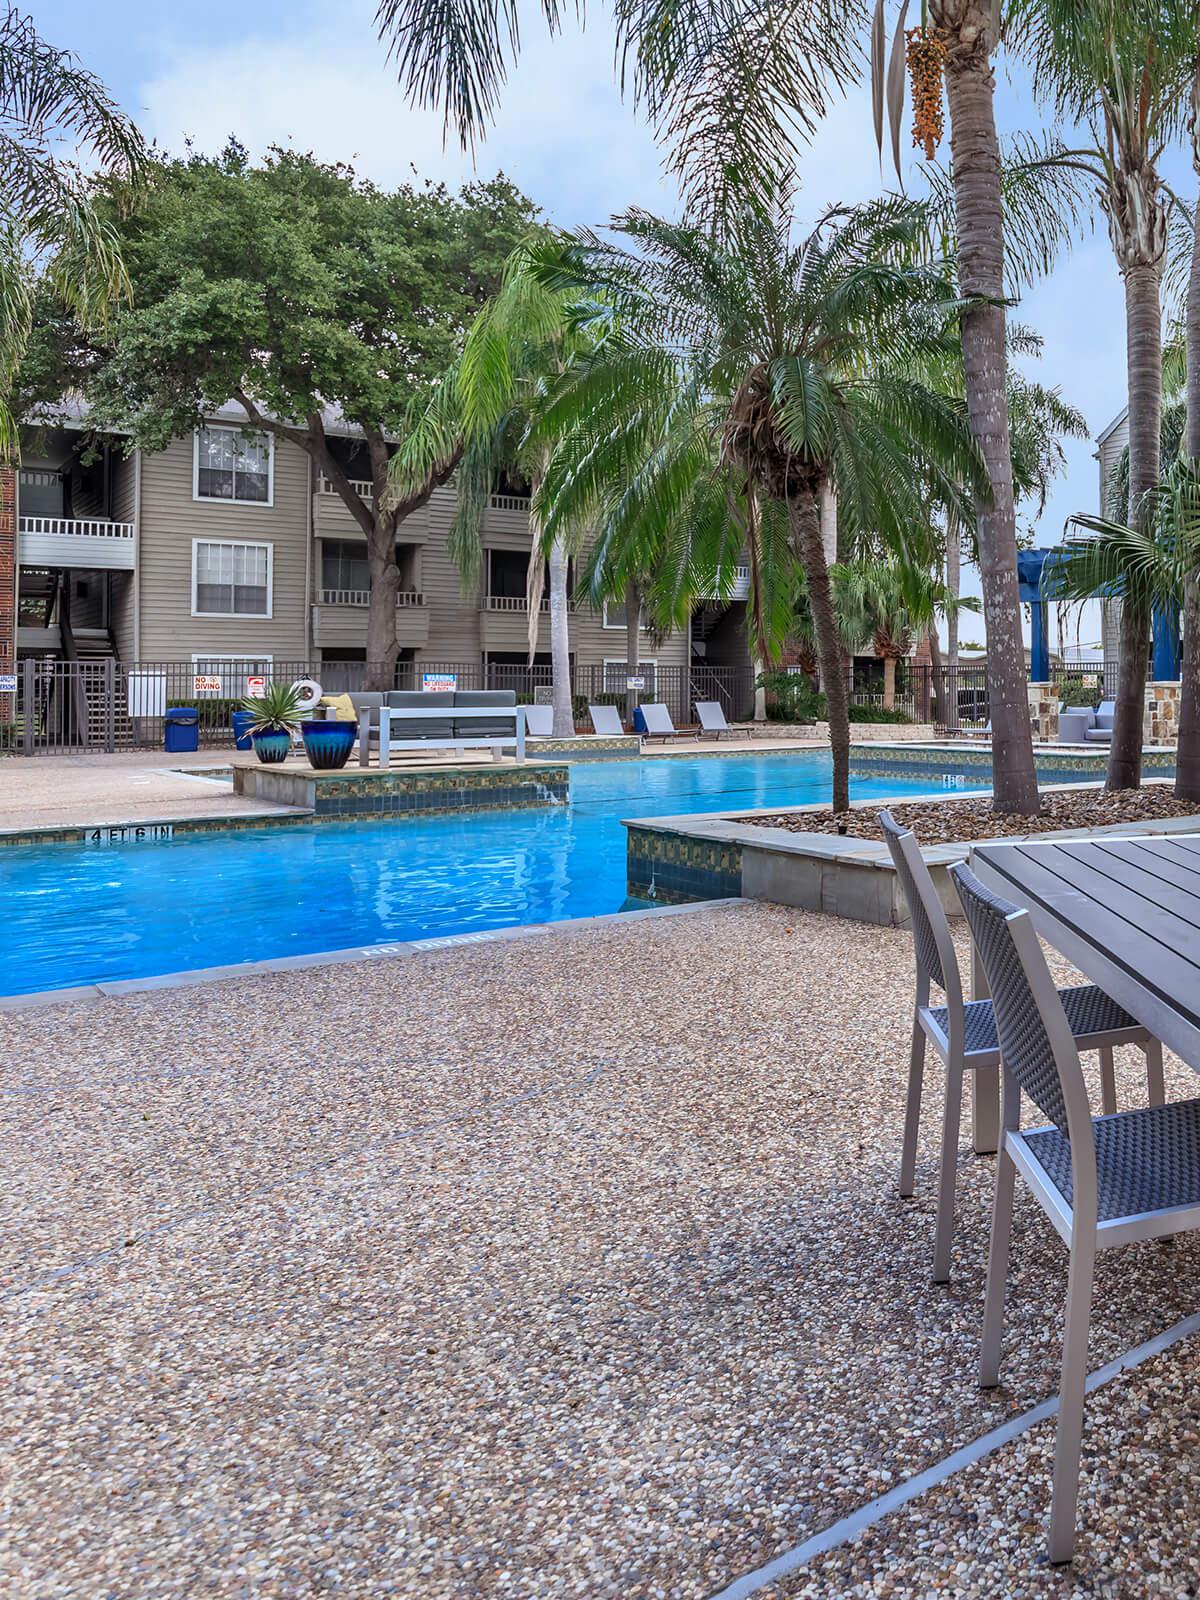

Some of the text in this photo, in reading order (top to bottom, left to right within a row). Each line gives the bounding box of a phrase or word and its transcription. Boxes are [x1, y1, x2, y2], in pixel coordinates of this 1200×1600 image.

[91, 826, 169, 843] 4 FT 6 IN
[361, 933, 496, 957] NO DIVING
